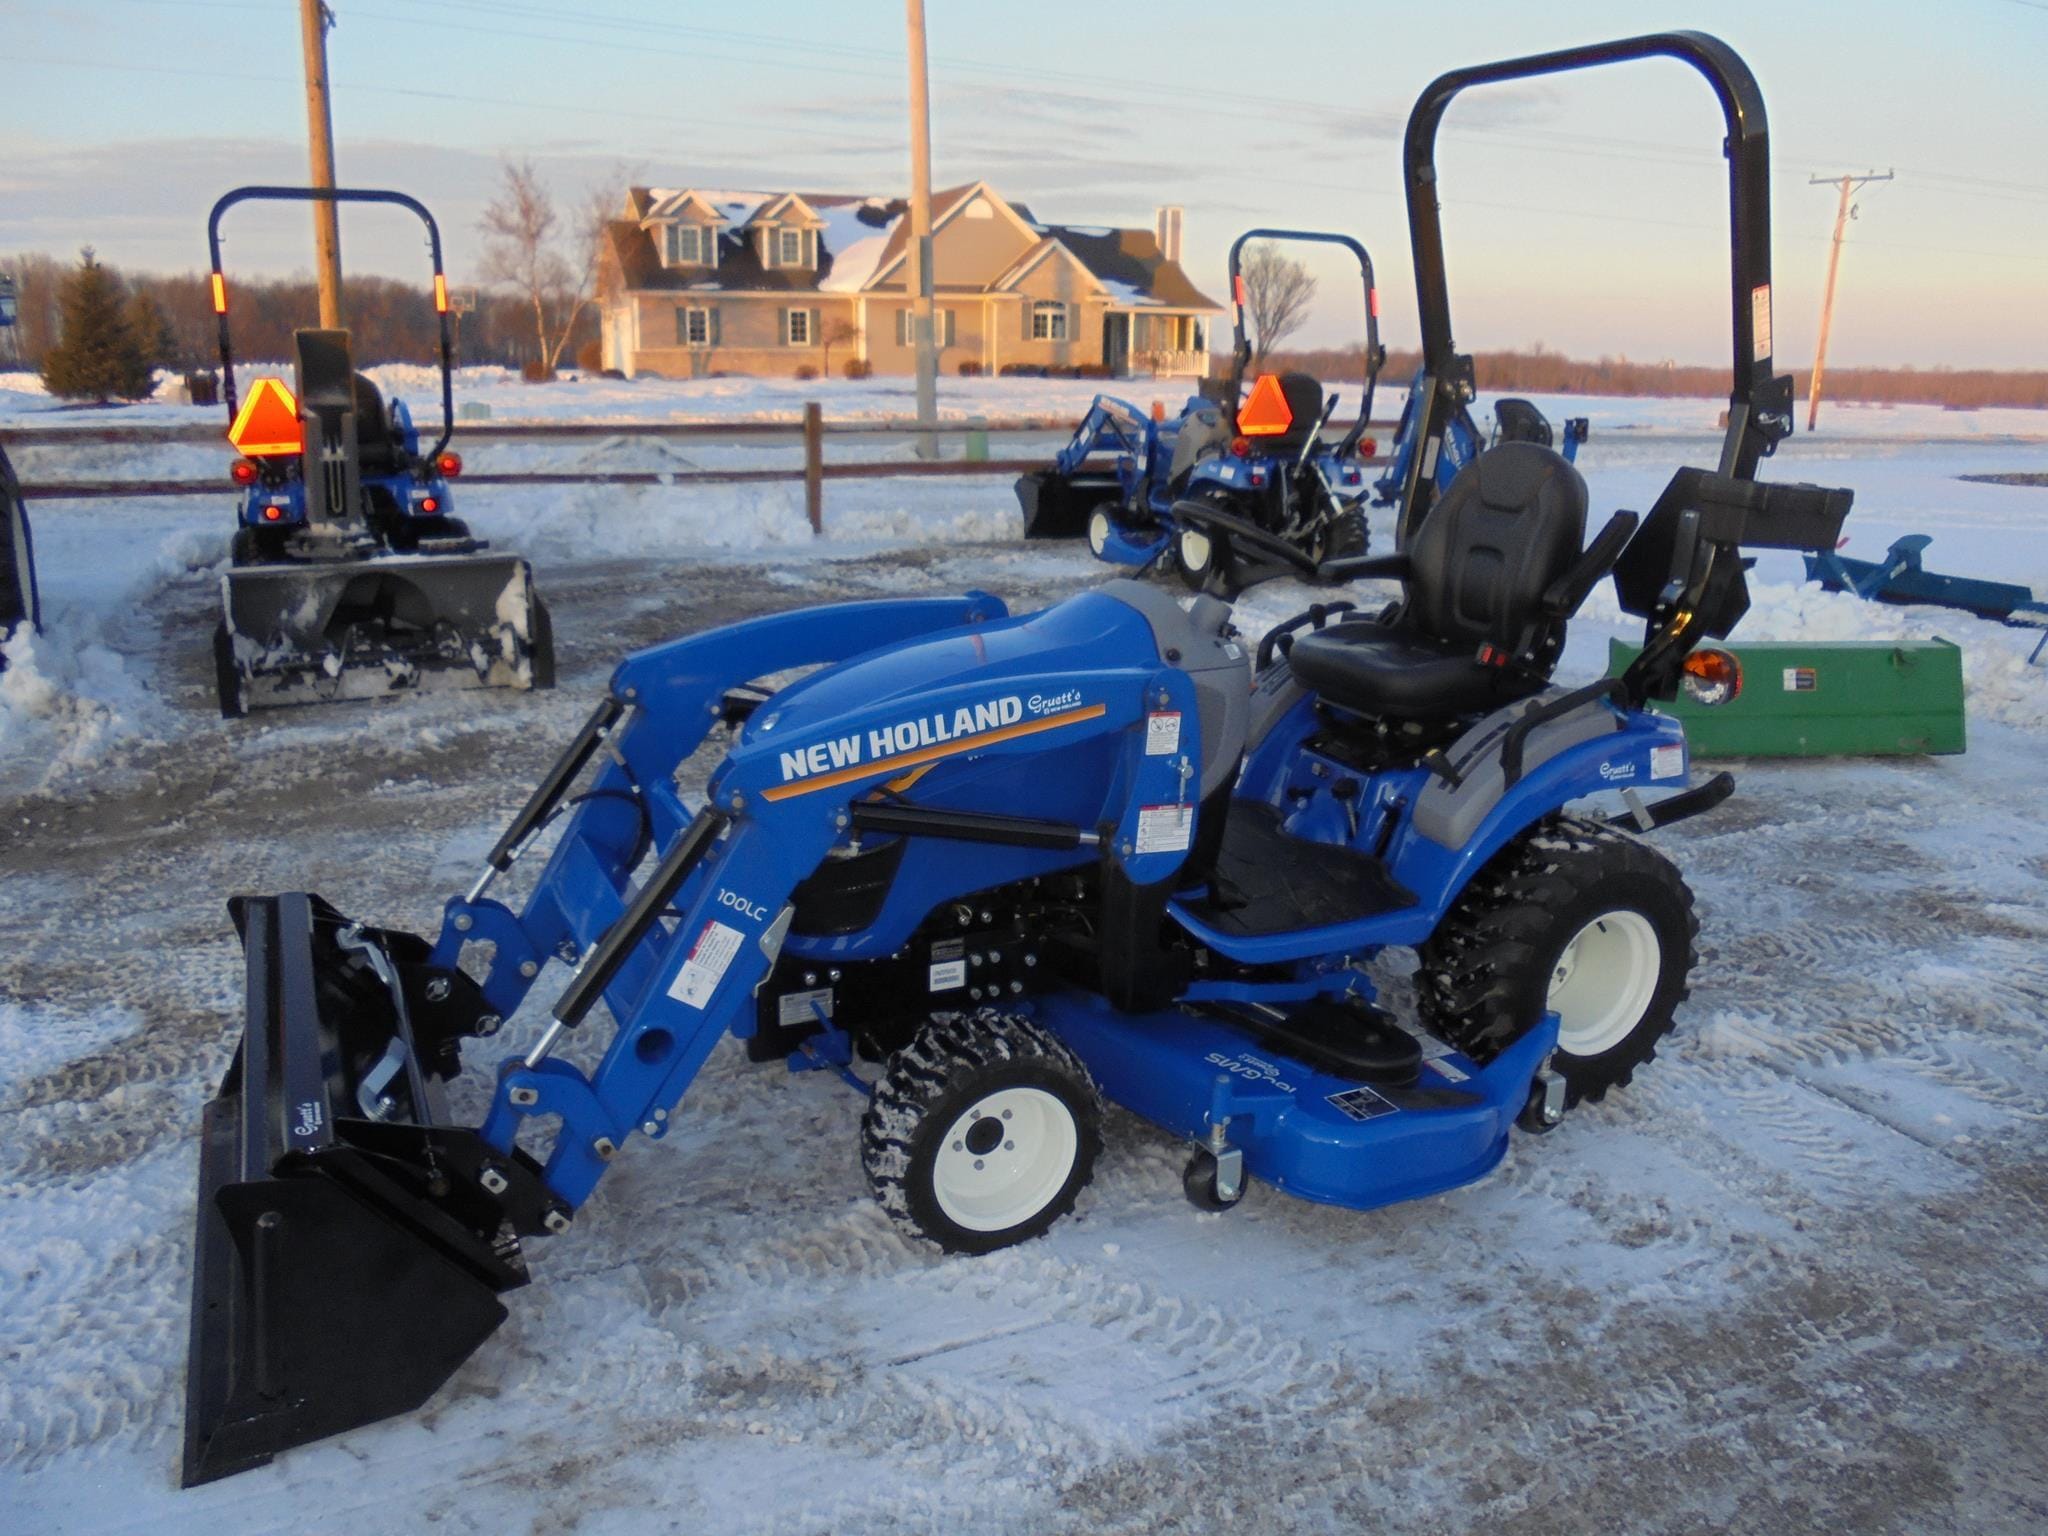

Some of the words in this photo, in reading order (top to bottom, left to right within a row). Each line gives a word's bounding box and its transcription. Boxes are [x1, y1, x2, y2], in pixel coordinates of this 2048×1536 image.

[1028, 688, 1081, 713] Gruett's
[780, 735, 861, 780] NEW
[869, 696, 1022, 758] HOLLAND
[717, 888, 768, 921] 100LC
